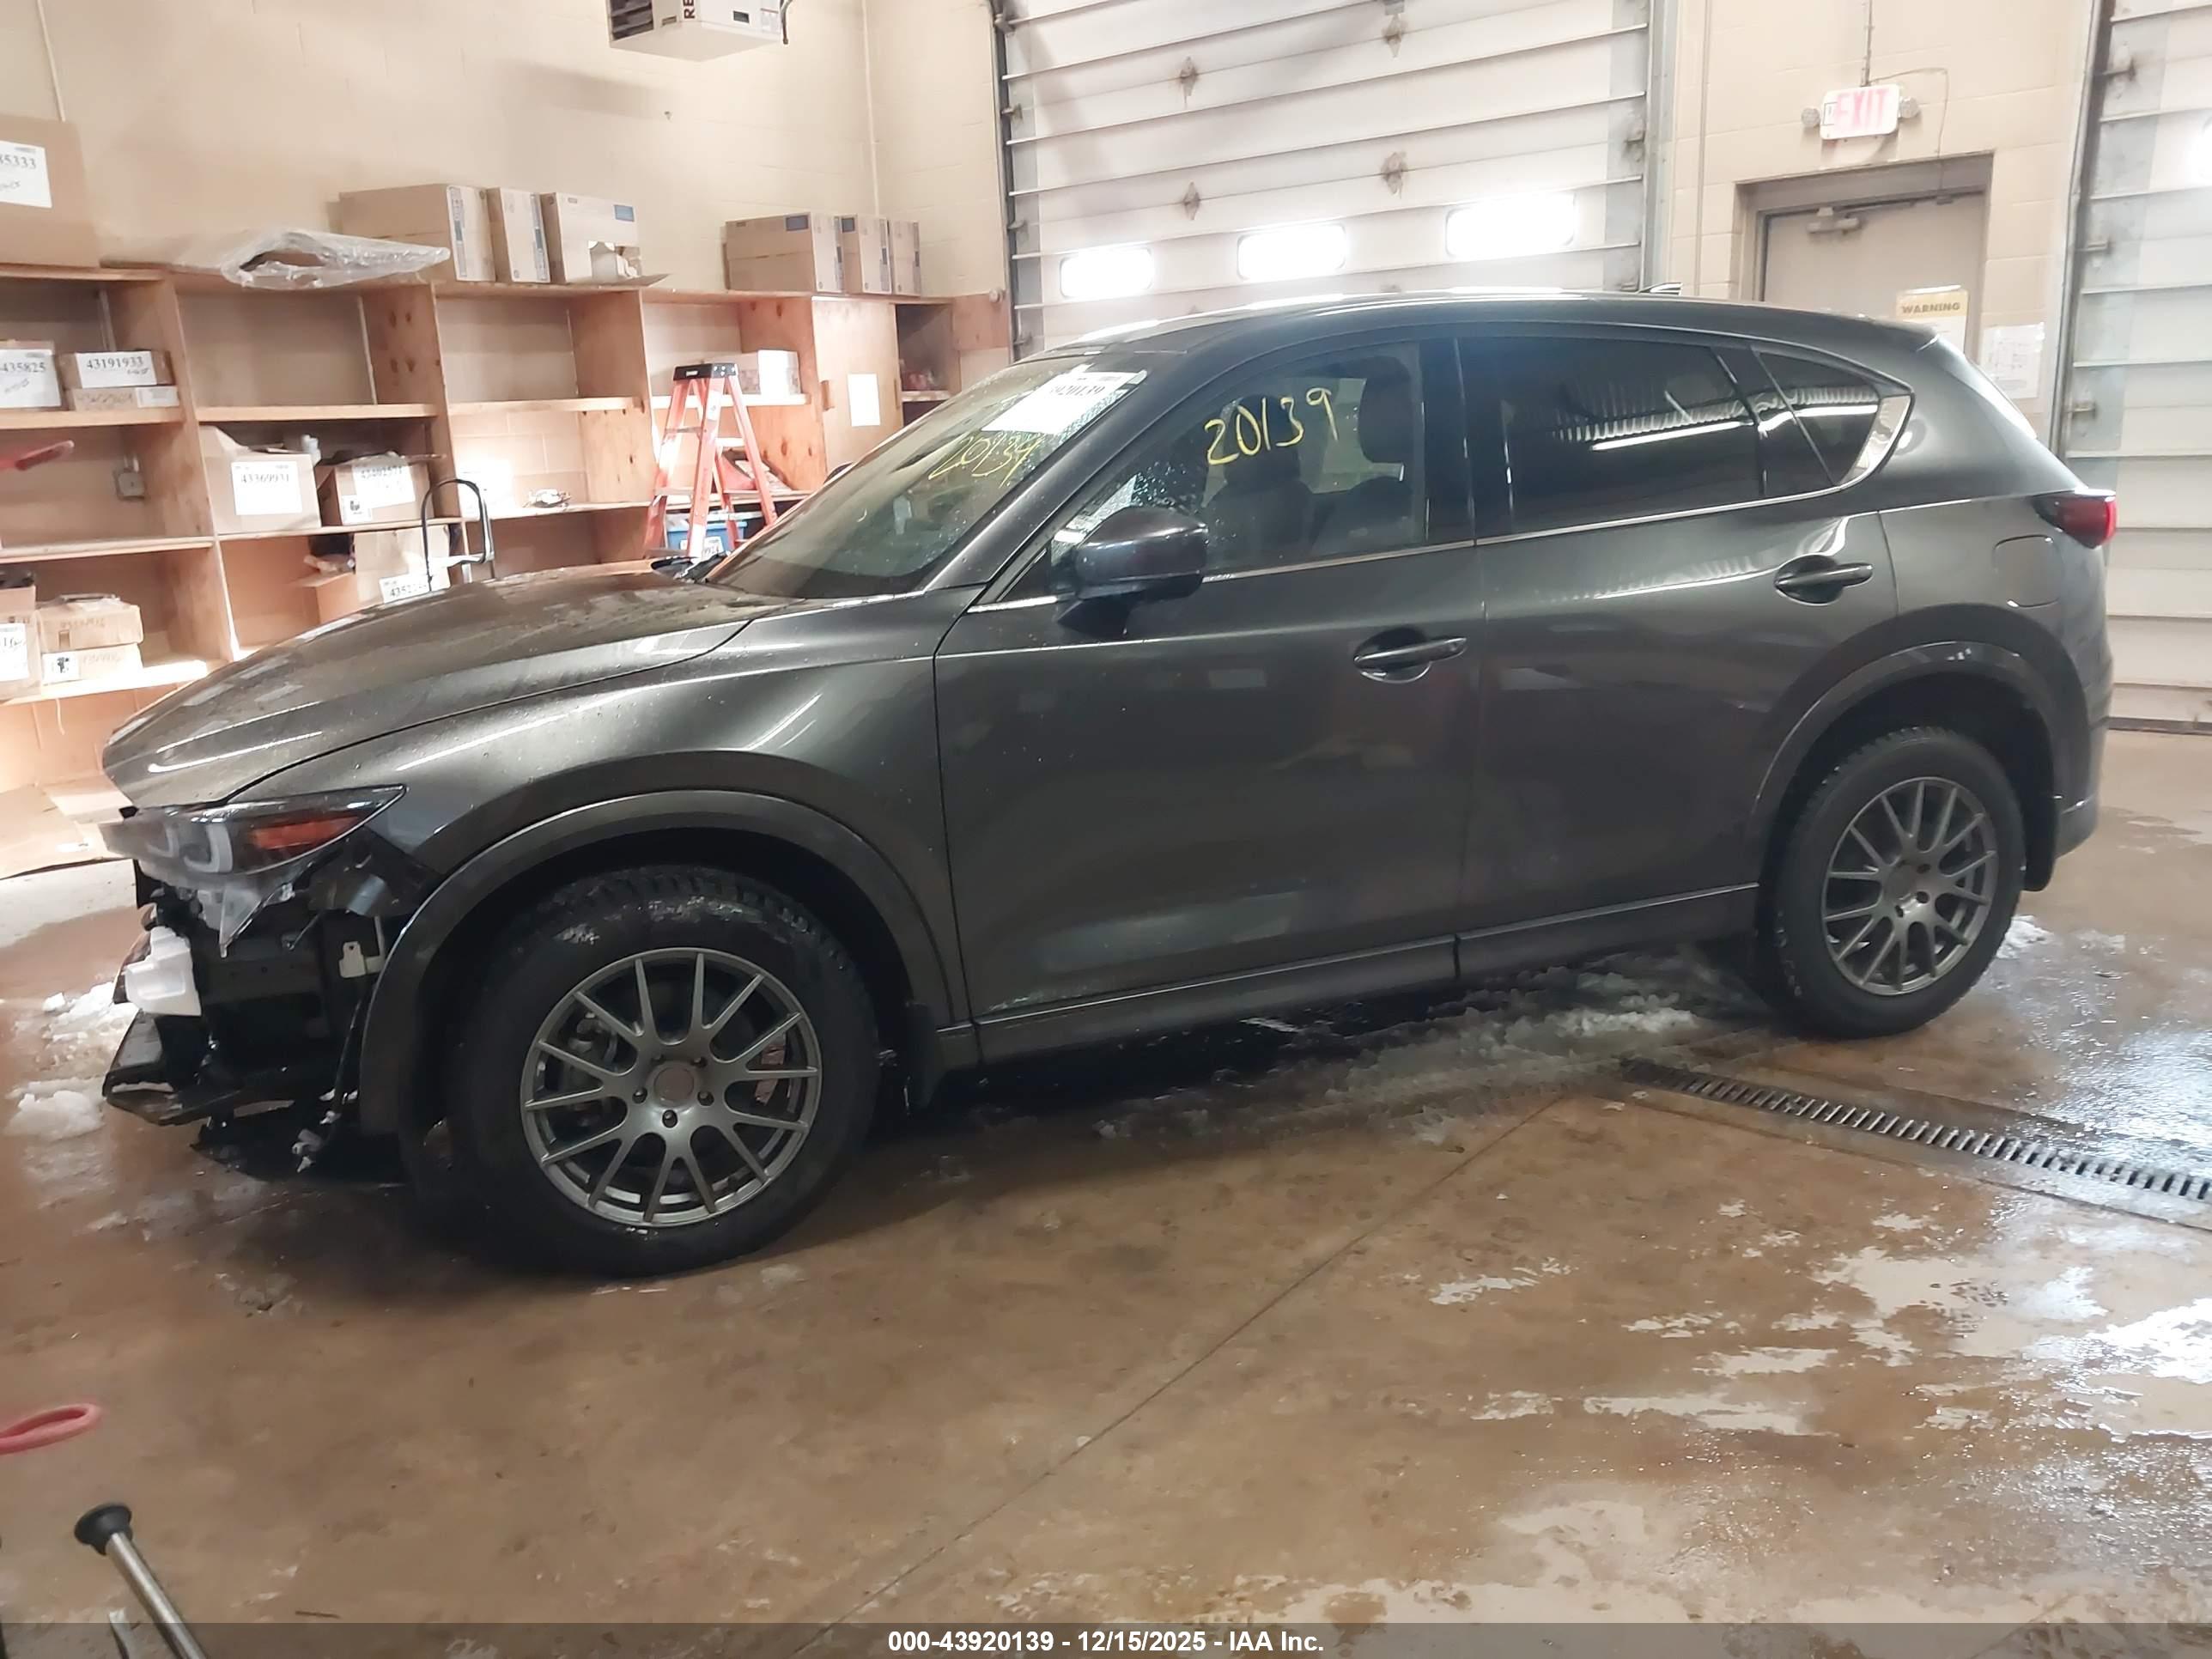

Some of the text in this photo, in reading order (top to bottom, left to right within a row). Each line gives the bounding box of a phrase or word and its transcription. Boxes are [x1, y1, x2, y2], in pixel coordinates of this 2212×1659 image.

[1835, 88, 1889, 131] EXIT
[1902, 301, 1960, 314] WARNING
[87, 356, 144, 370] 43191933
[1205, 387, 1338, 465] 20139
[928, 433, 1044, 489] 20139
